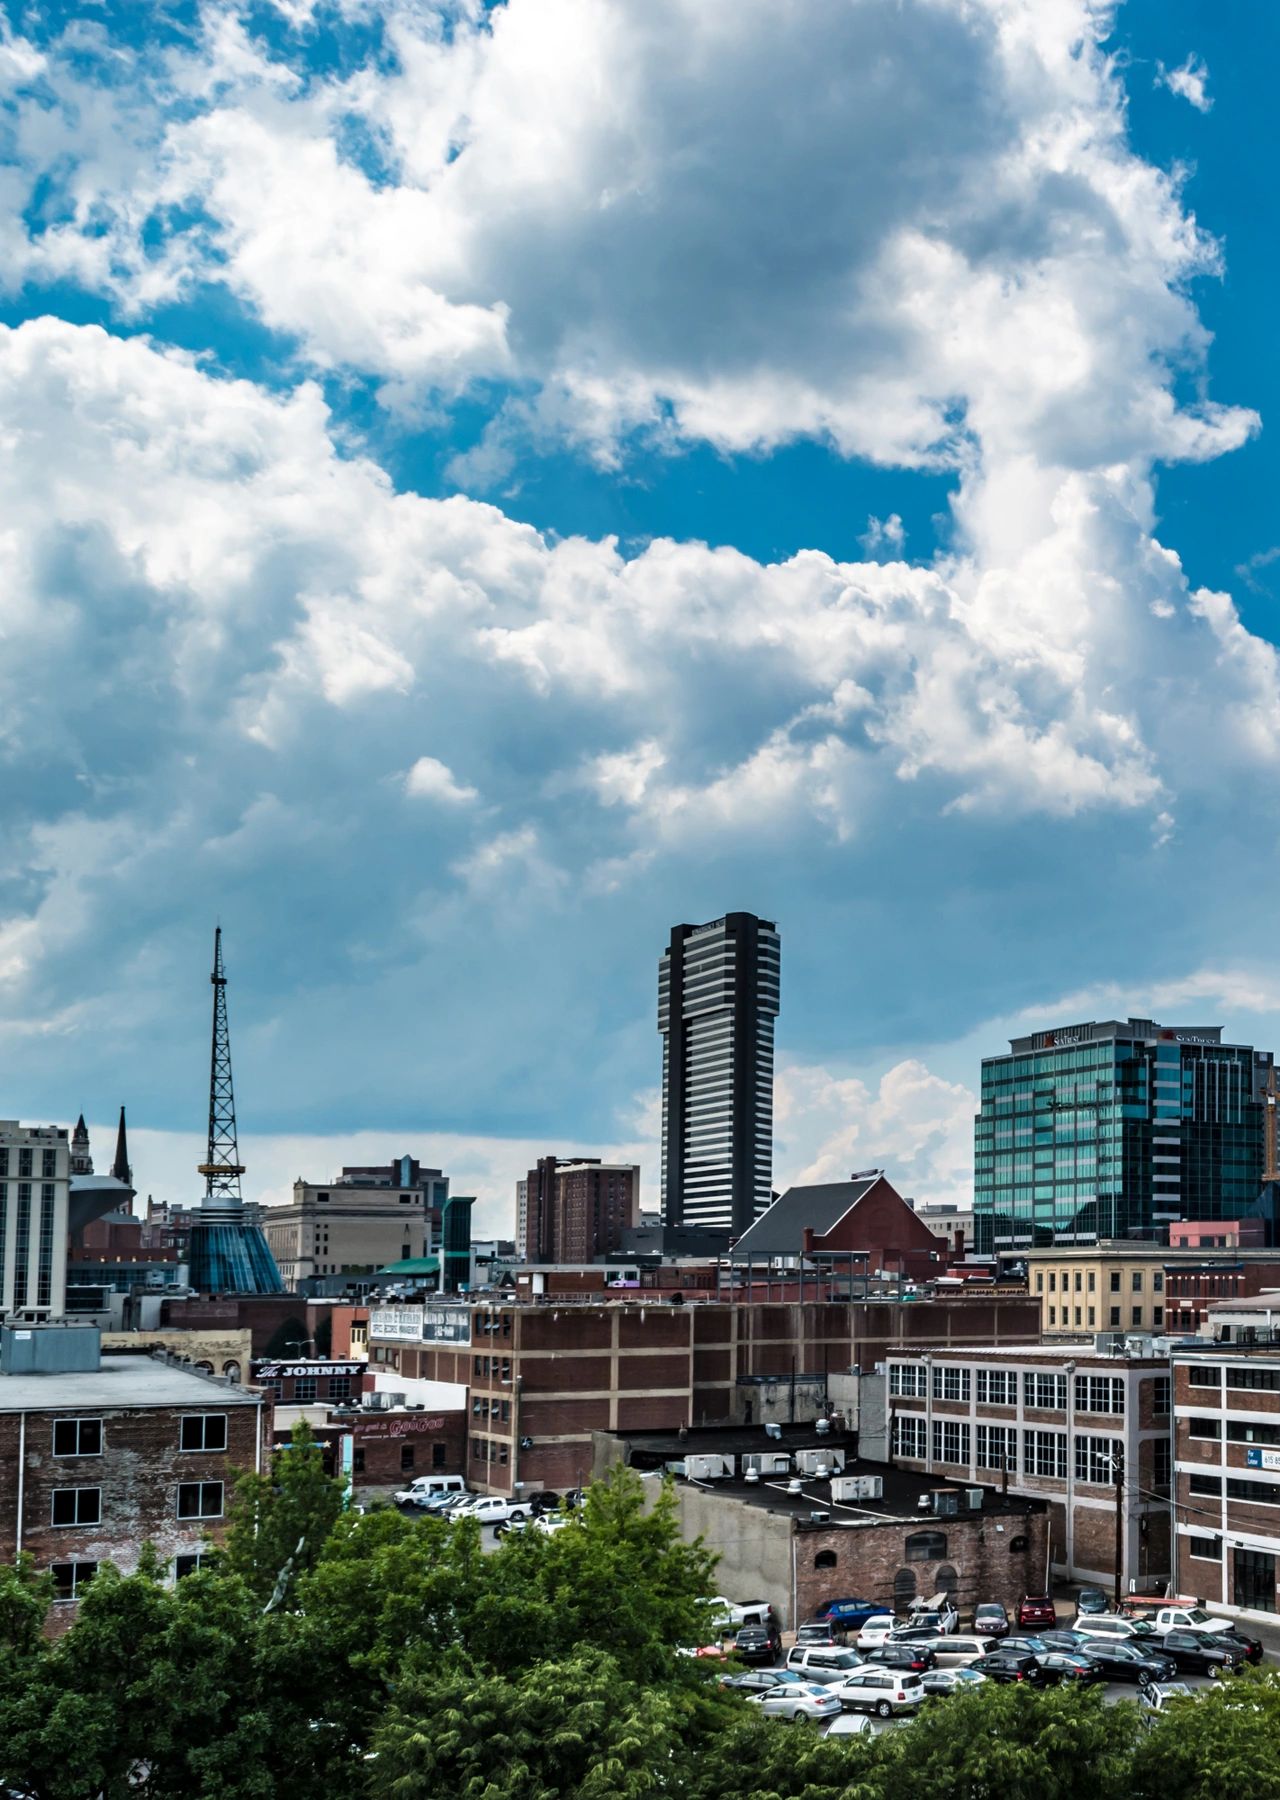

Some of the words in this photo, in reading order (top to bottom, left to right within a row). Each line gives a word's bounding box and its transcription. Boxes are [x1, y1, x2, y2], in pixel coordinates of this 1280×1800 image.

[255, 1366, 281, 1378] The
[283, 1365, 361, 1377] JOHNNY
[1264, 1456, 1274, 1464] 615
